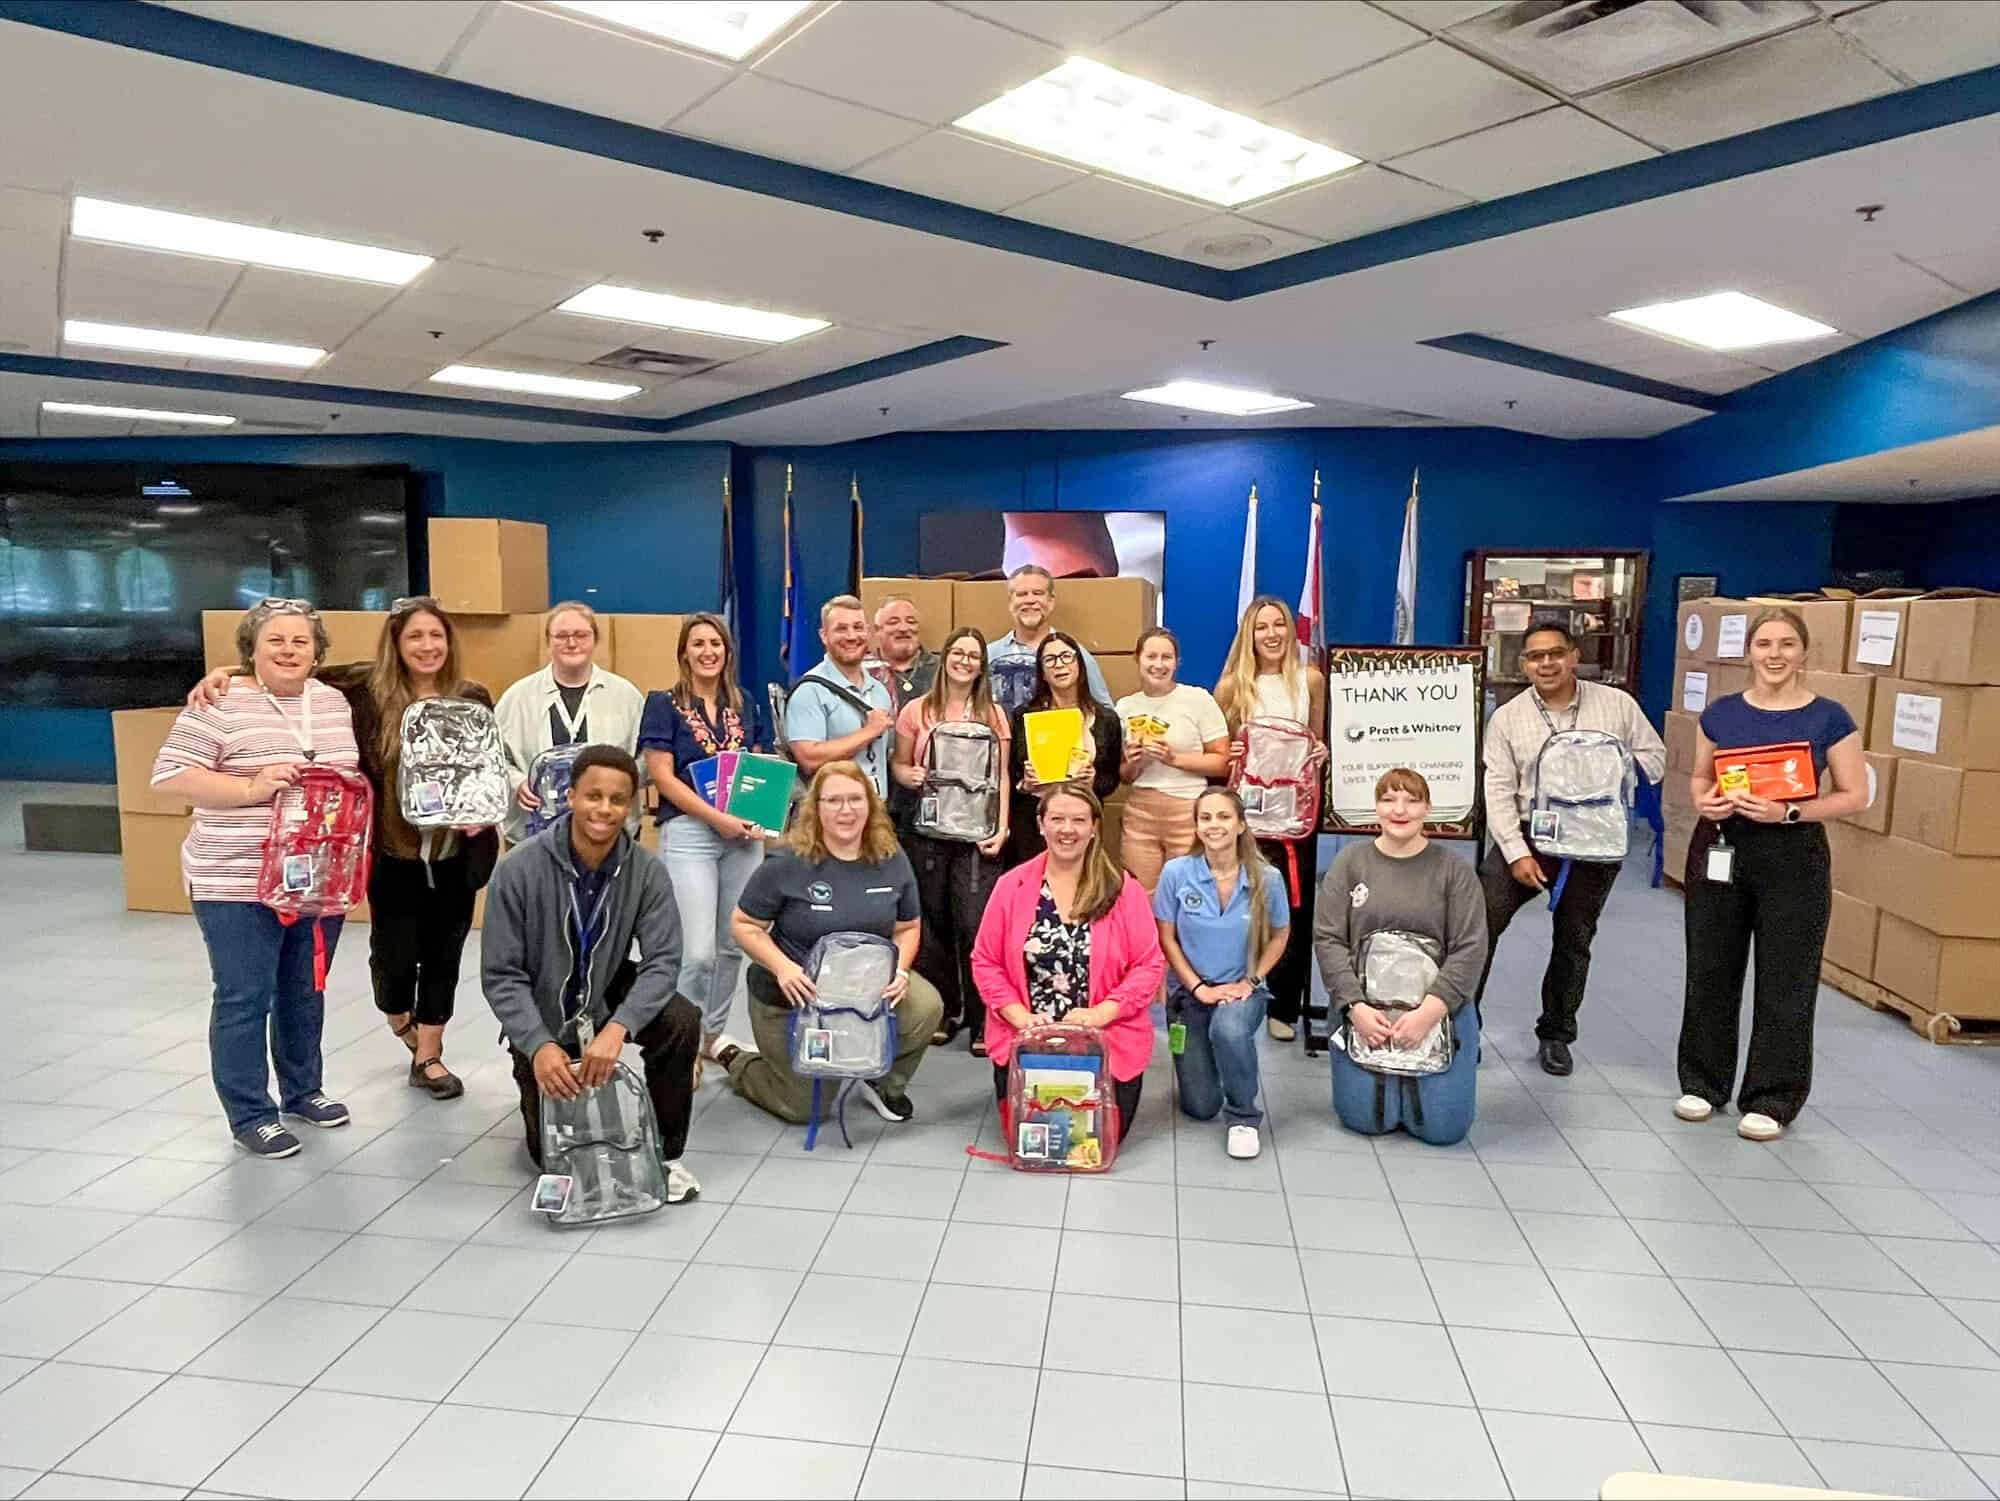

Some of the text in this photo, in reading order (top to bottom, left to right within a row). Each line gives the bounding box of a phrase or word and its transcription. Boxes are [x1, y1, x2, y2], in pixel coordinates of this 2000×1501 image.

[1341, 684, 1458, 703] THANK YOU
[1369, 723, 1462, 735] Pratt & Whitney
[1342, 763, 1363, 771] YOUR
[1420, 761, 1464, 769] CHANGING
